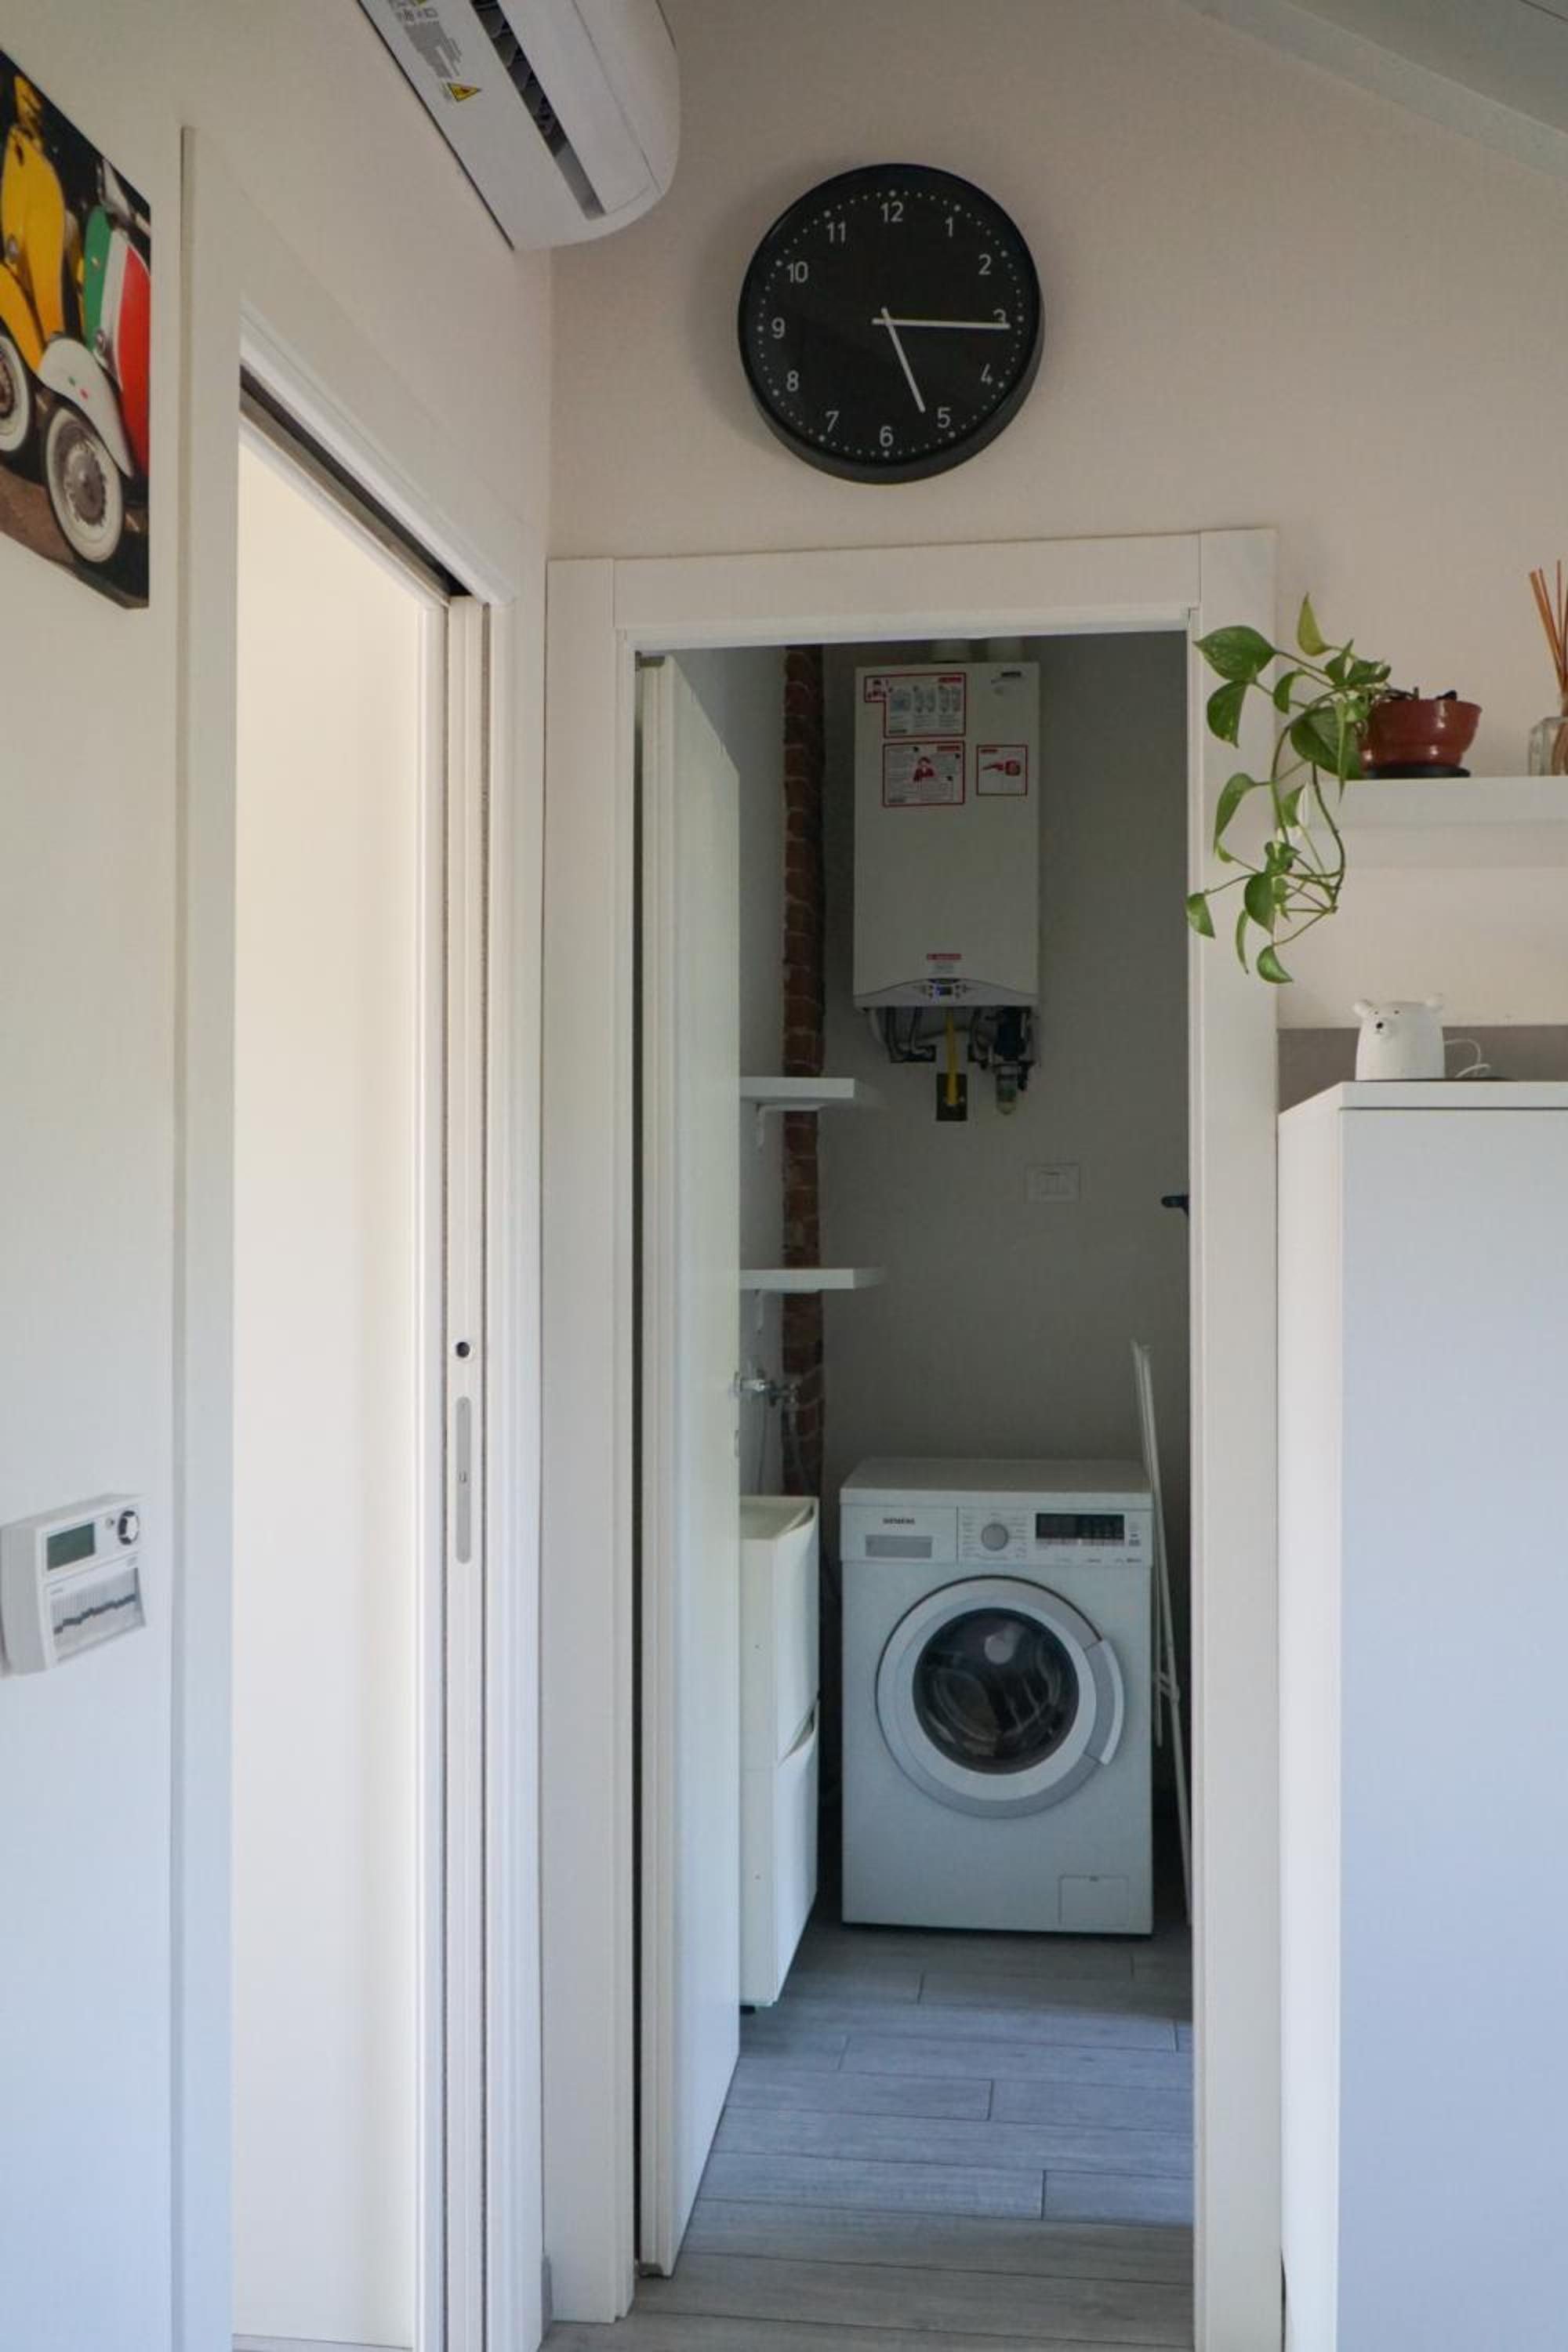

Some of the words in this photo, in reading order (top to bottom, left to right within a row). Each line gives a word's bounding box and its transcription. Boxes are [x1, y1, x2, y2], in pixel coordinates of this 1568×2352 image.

[880, 200, 904, 223] 12
[826, 221, 847, 243] 11
[945, 216, 954, 238] 1
[786, 260, 809, 283] 10
[978, 253, 992, 276] 2
[771, 317, 786, 339] 9
[786, 370, 800, 391] 8
[980, 362, 993, 384] 4
[825, 410, 840, 433] 7
[937, 406, 951, 429] 5
[879, 426, 894, 448] 6
